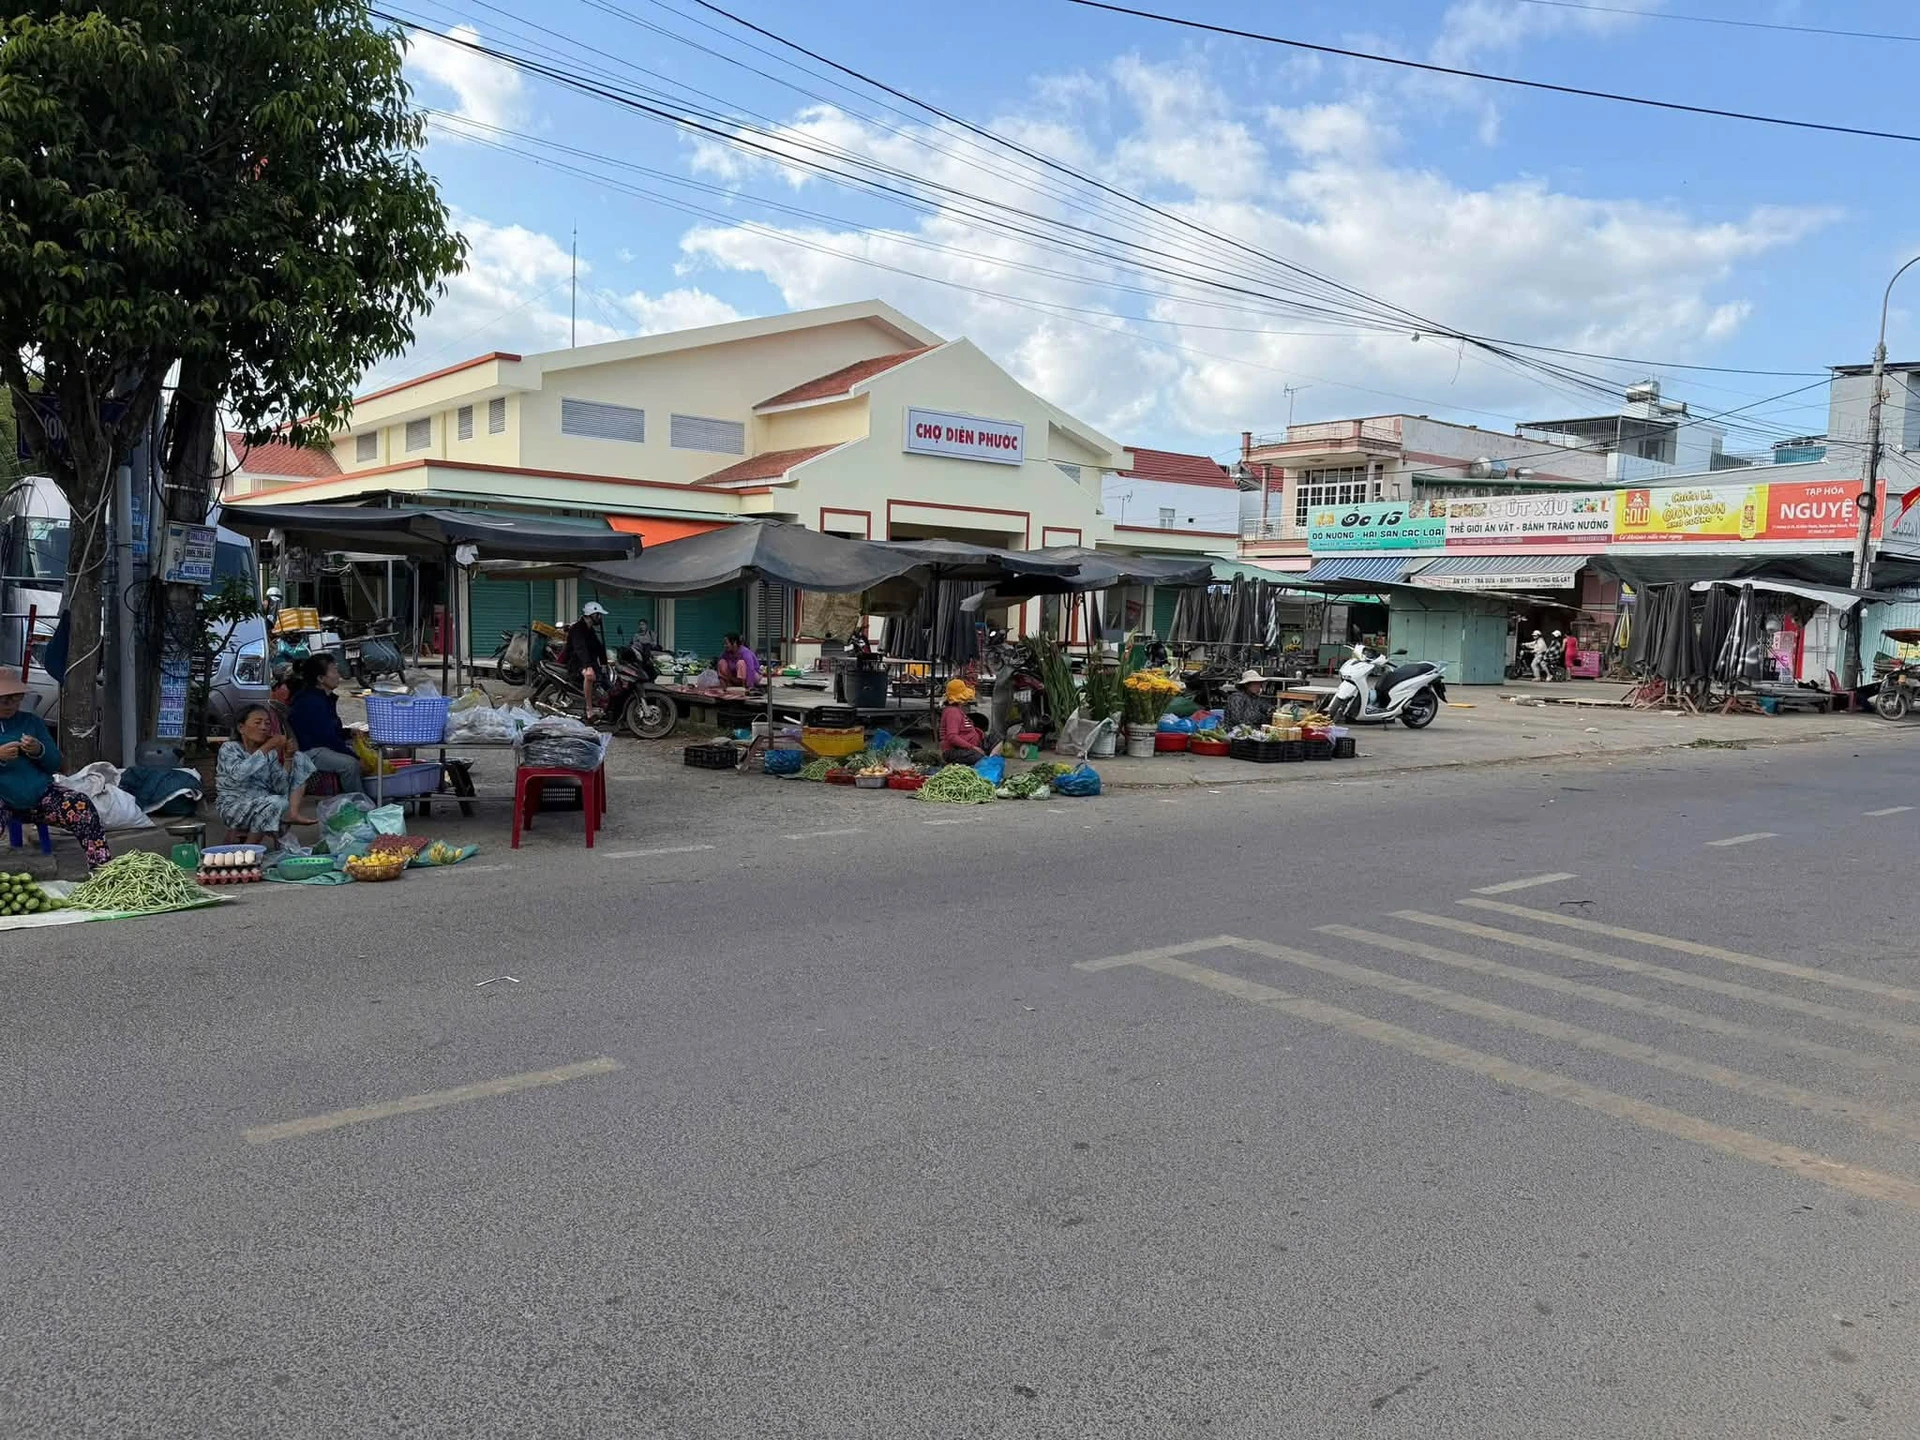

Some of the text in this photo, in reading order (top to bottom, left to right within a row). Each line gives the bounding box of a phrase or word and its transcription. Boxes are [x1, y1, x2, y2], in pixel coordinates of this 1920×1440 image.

[915, 423, 942, 443] CHỢ
[978, 431, 1018, 450] PHƯỚC
[1622, 508, 1650, 525] GOLD
[1780, 498, 1861, 522] NGUYỆ
